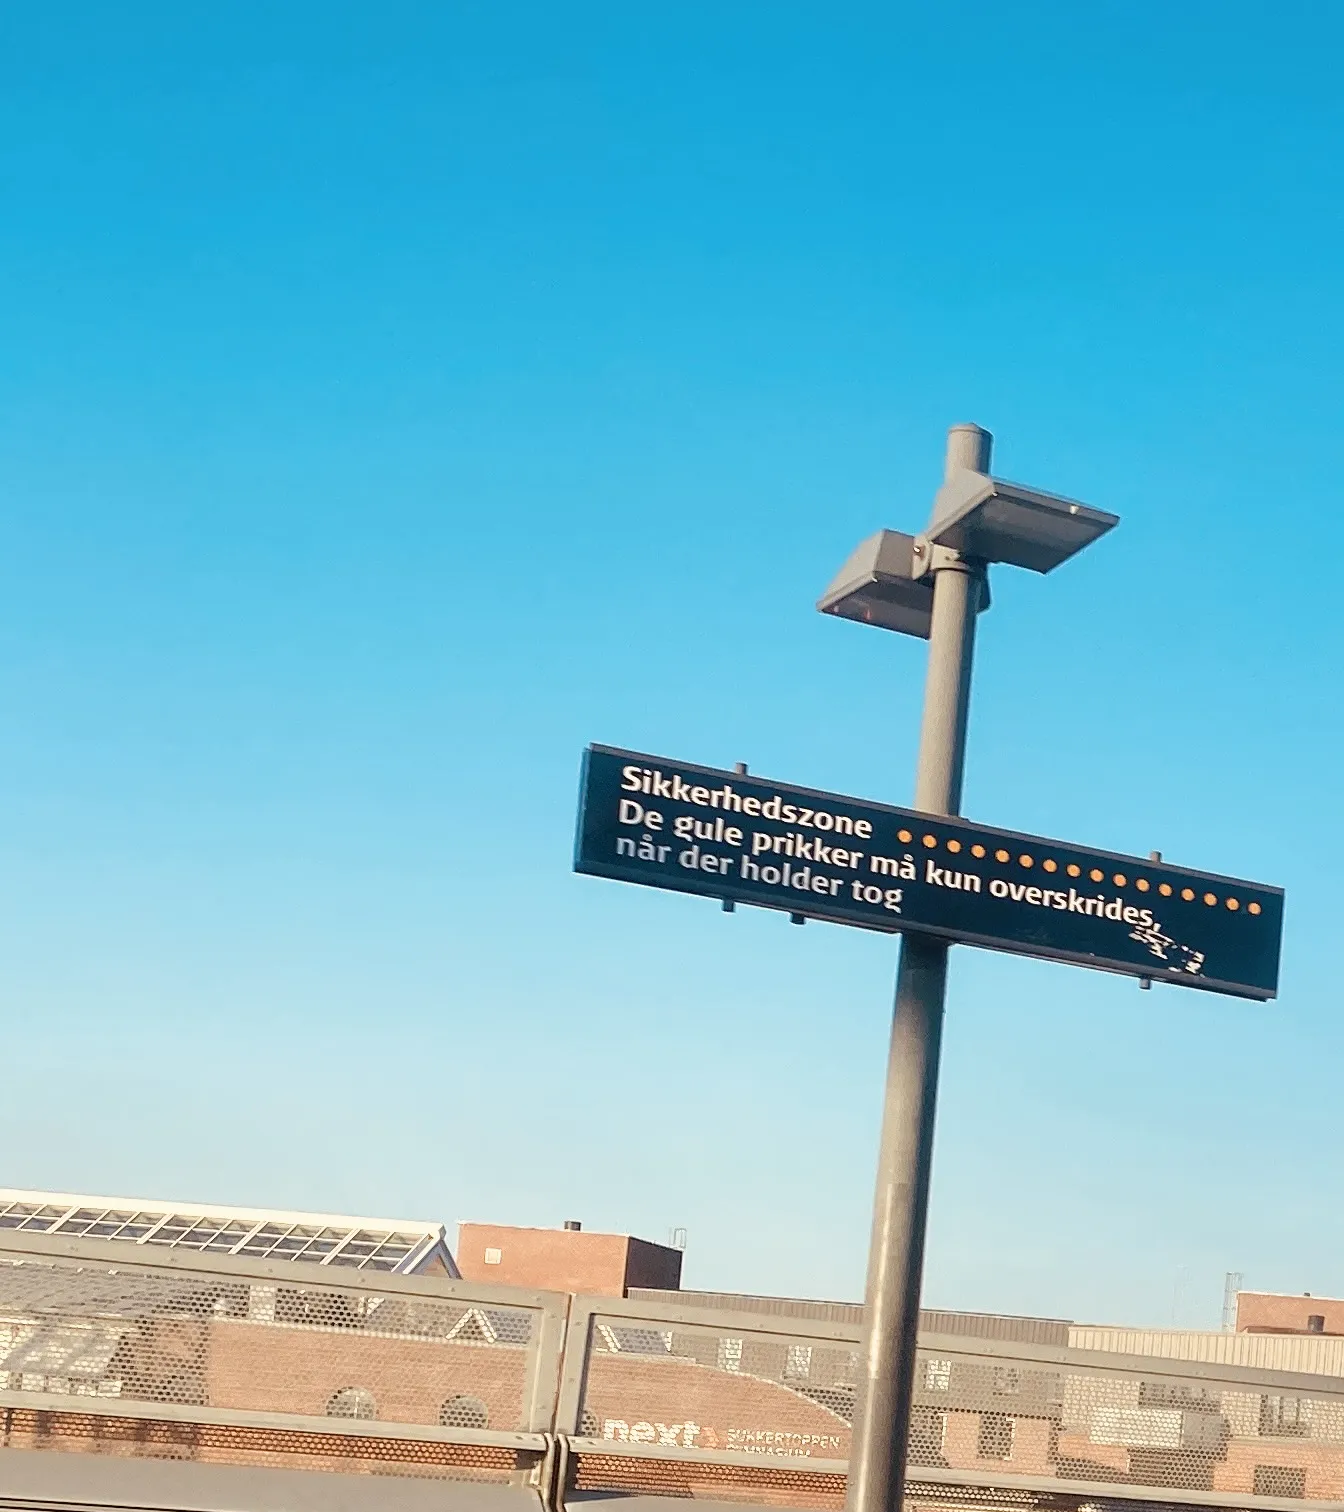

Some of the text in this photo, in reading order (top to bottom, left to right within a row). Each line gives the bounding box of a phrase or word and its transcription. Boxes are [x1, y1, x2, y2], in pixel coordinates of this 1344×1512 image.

[621, 765, 873, 839] Sikkerhedszone
[616, 833, 903, 913] når der holder tog
[618, 798, 663, 831] De
[673, 814, 743, 847] gule
[752, 830, 864, 869] prikker
[870, 853, 916, 880] må
[926, 859, 981, 893] kun
[603, 1418, 701, 1449] next
